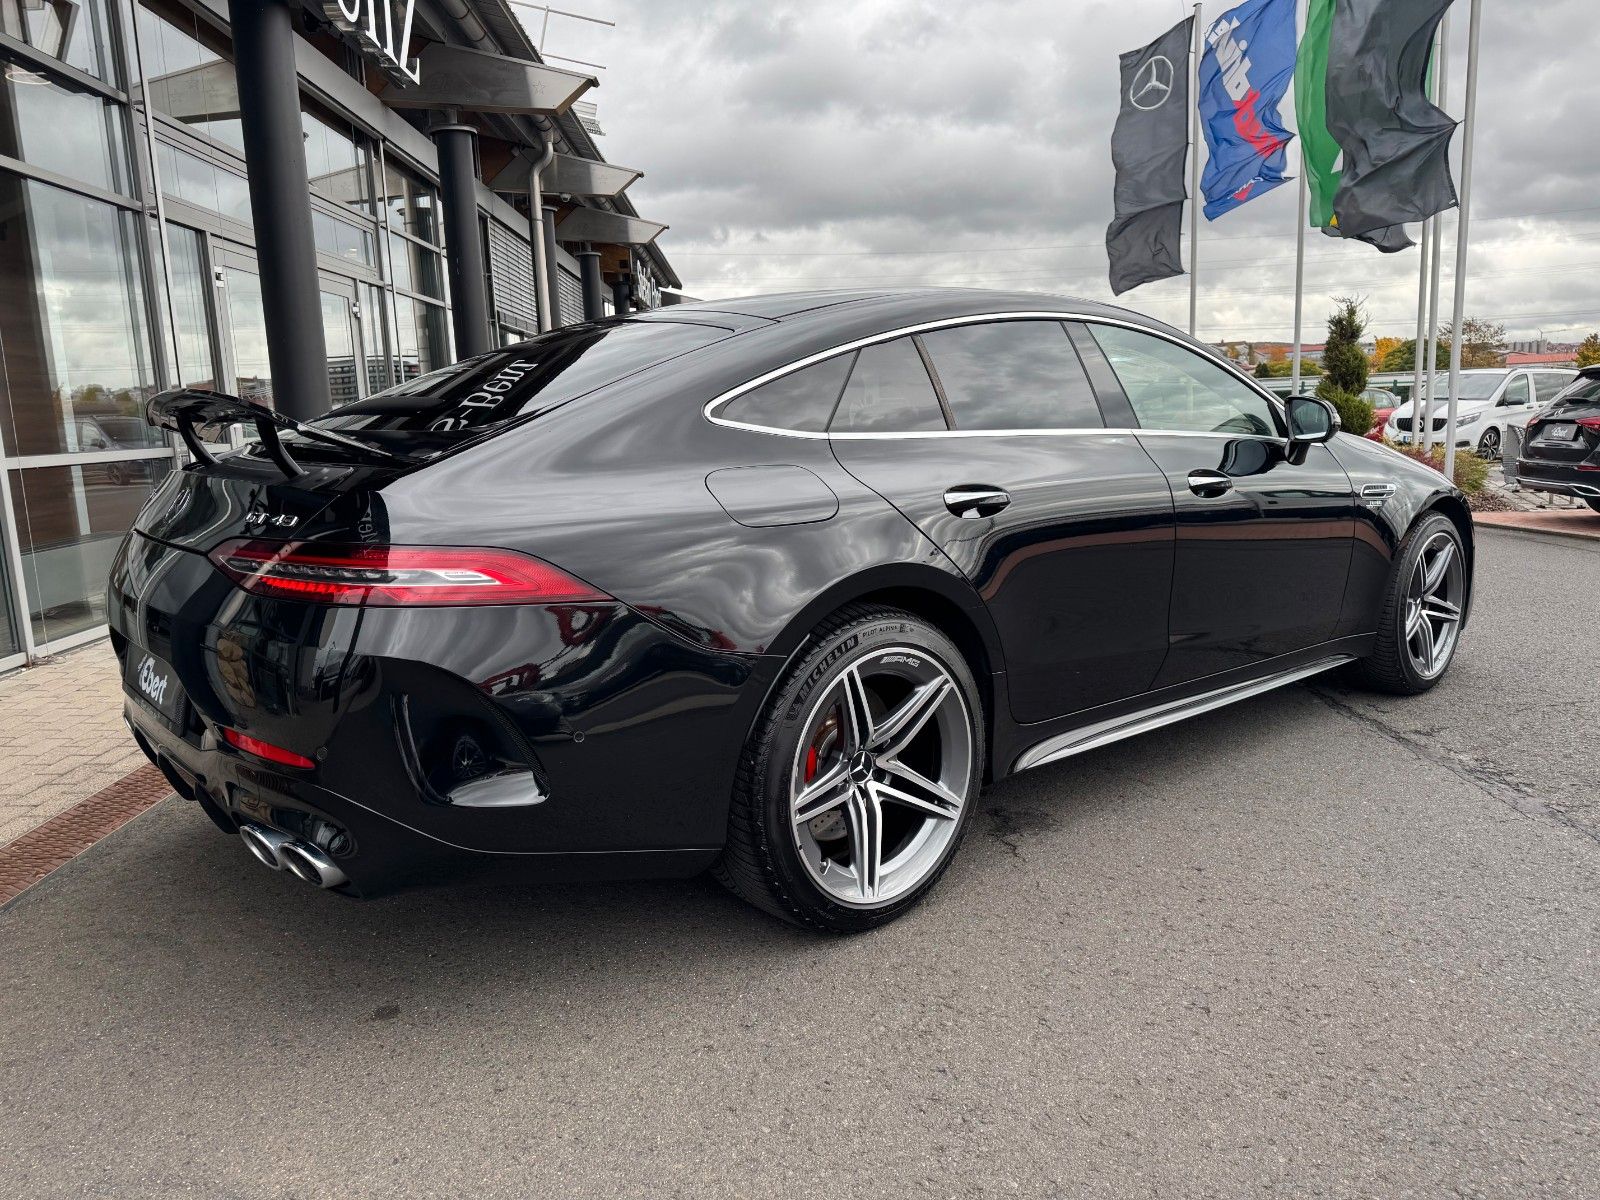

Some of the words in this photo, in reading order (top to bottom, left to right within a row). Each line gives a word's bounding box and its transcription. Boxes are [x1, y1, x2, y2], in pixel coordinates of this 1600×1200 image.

[799, 636, 858, 700] MICHELIN
[862, 628, 877, 638] PILOT
[891, 655, 921, 668] AMG
